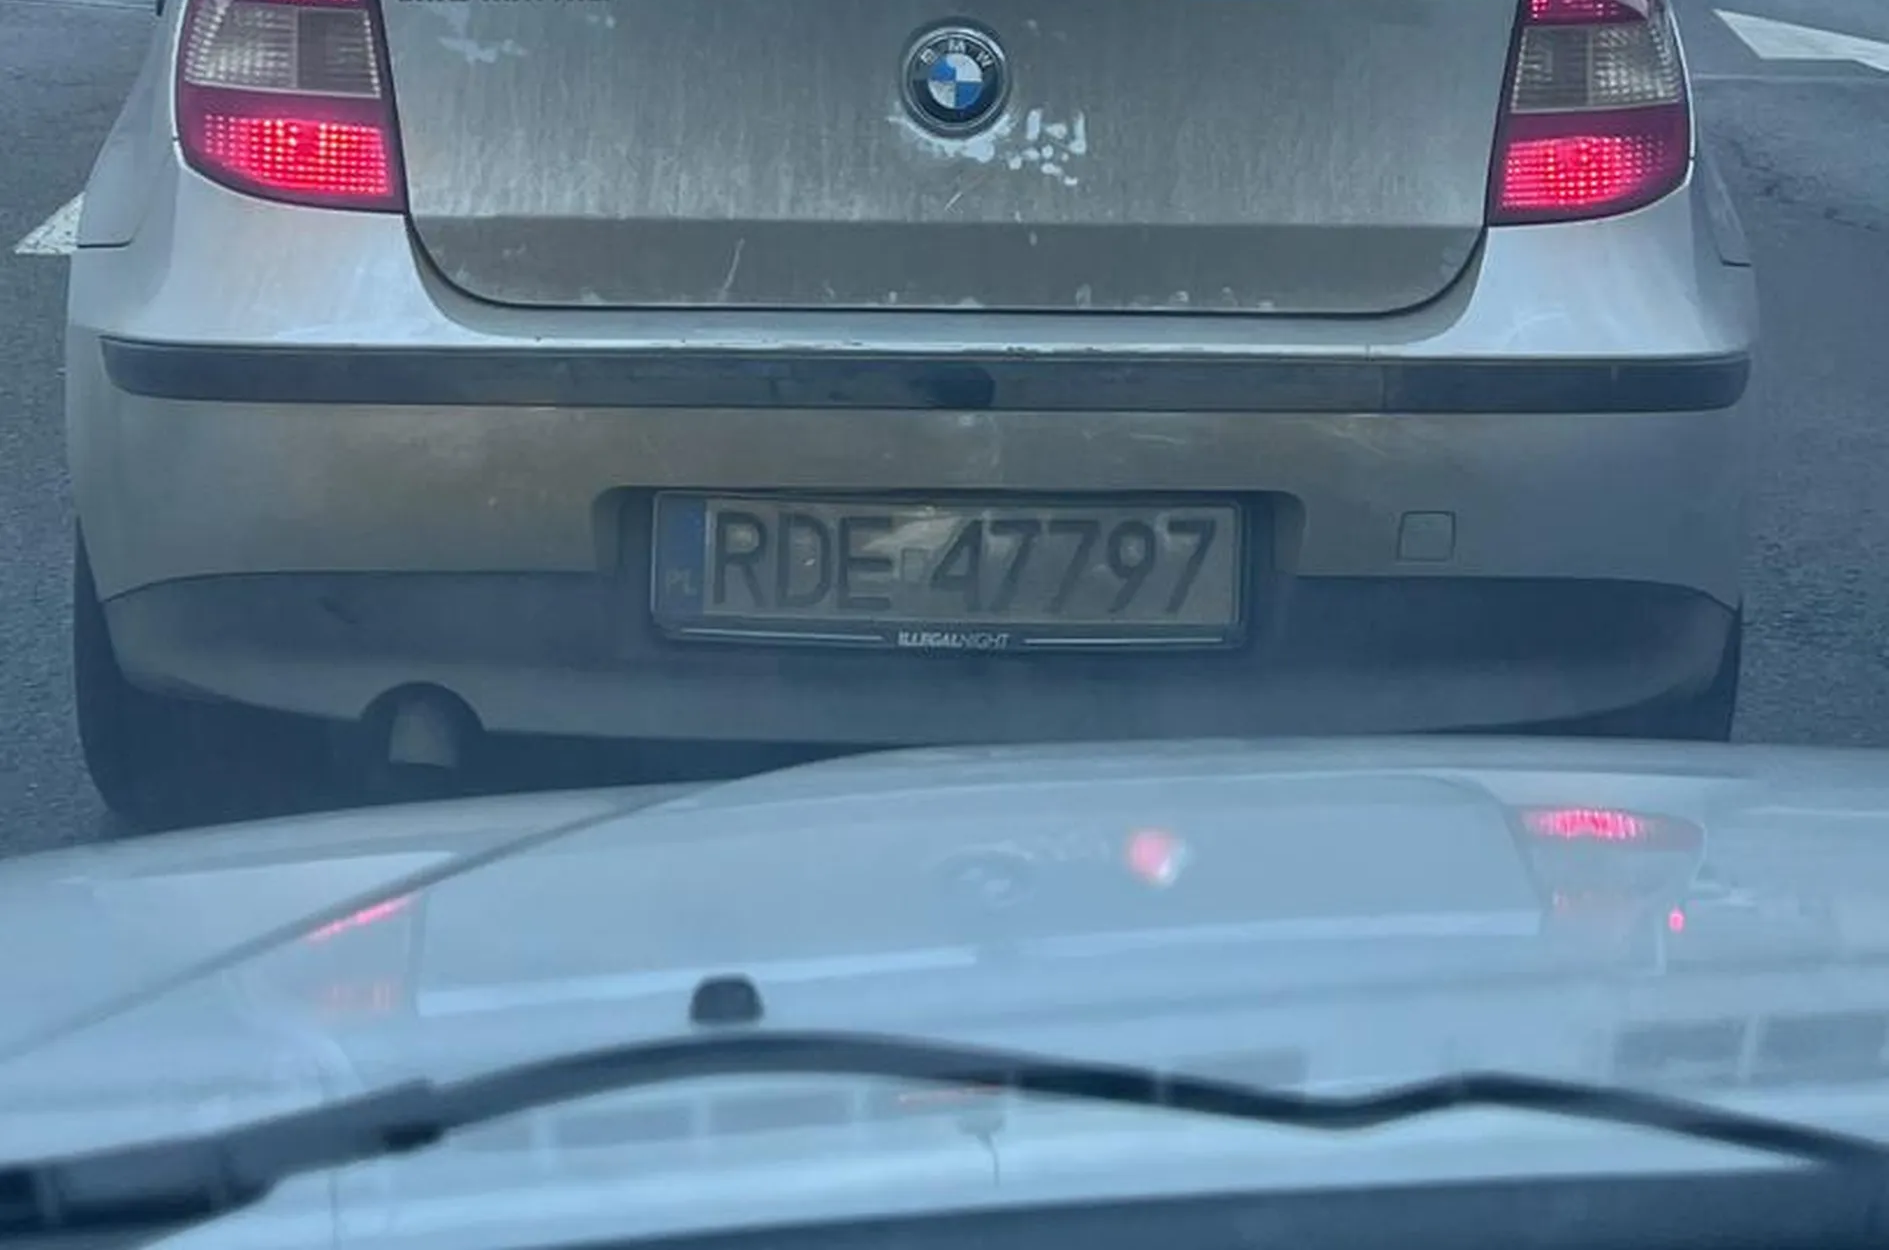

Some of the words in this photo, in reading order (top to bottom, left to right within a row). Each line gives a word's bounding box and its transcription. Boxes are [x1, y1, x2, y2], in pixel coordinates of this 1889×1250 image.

[920, 37, 994, 68] BMW
[711, 510, 893, 612] RDE
[929, 515, 1217, 615] 47797
